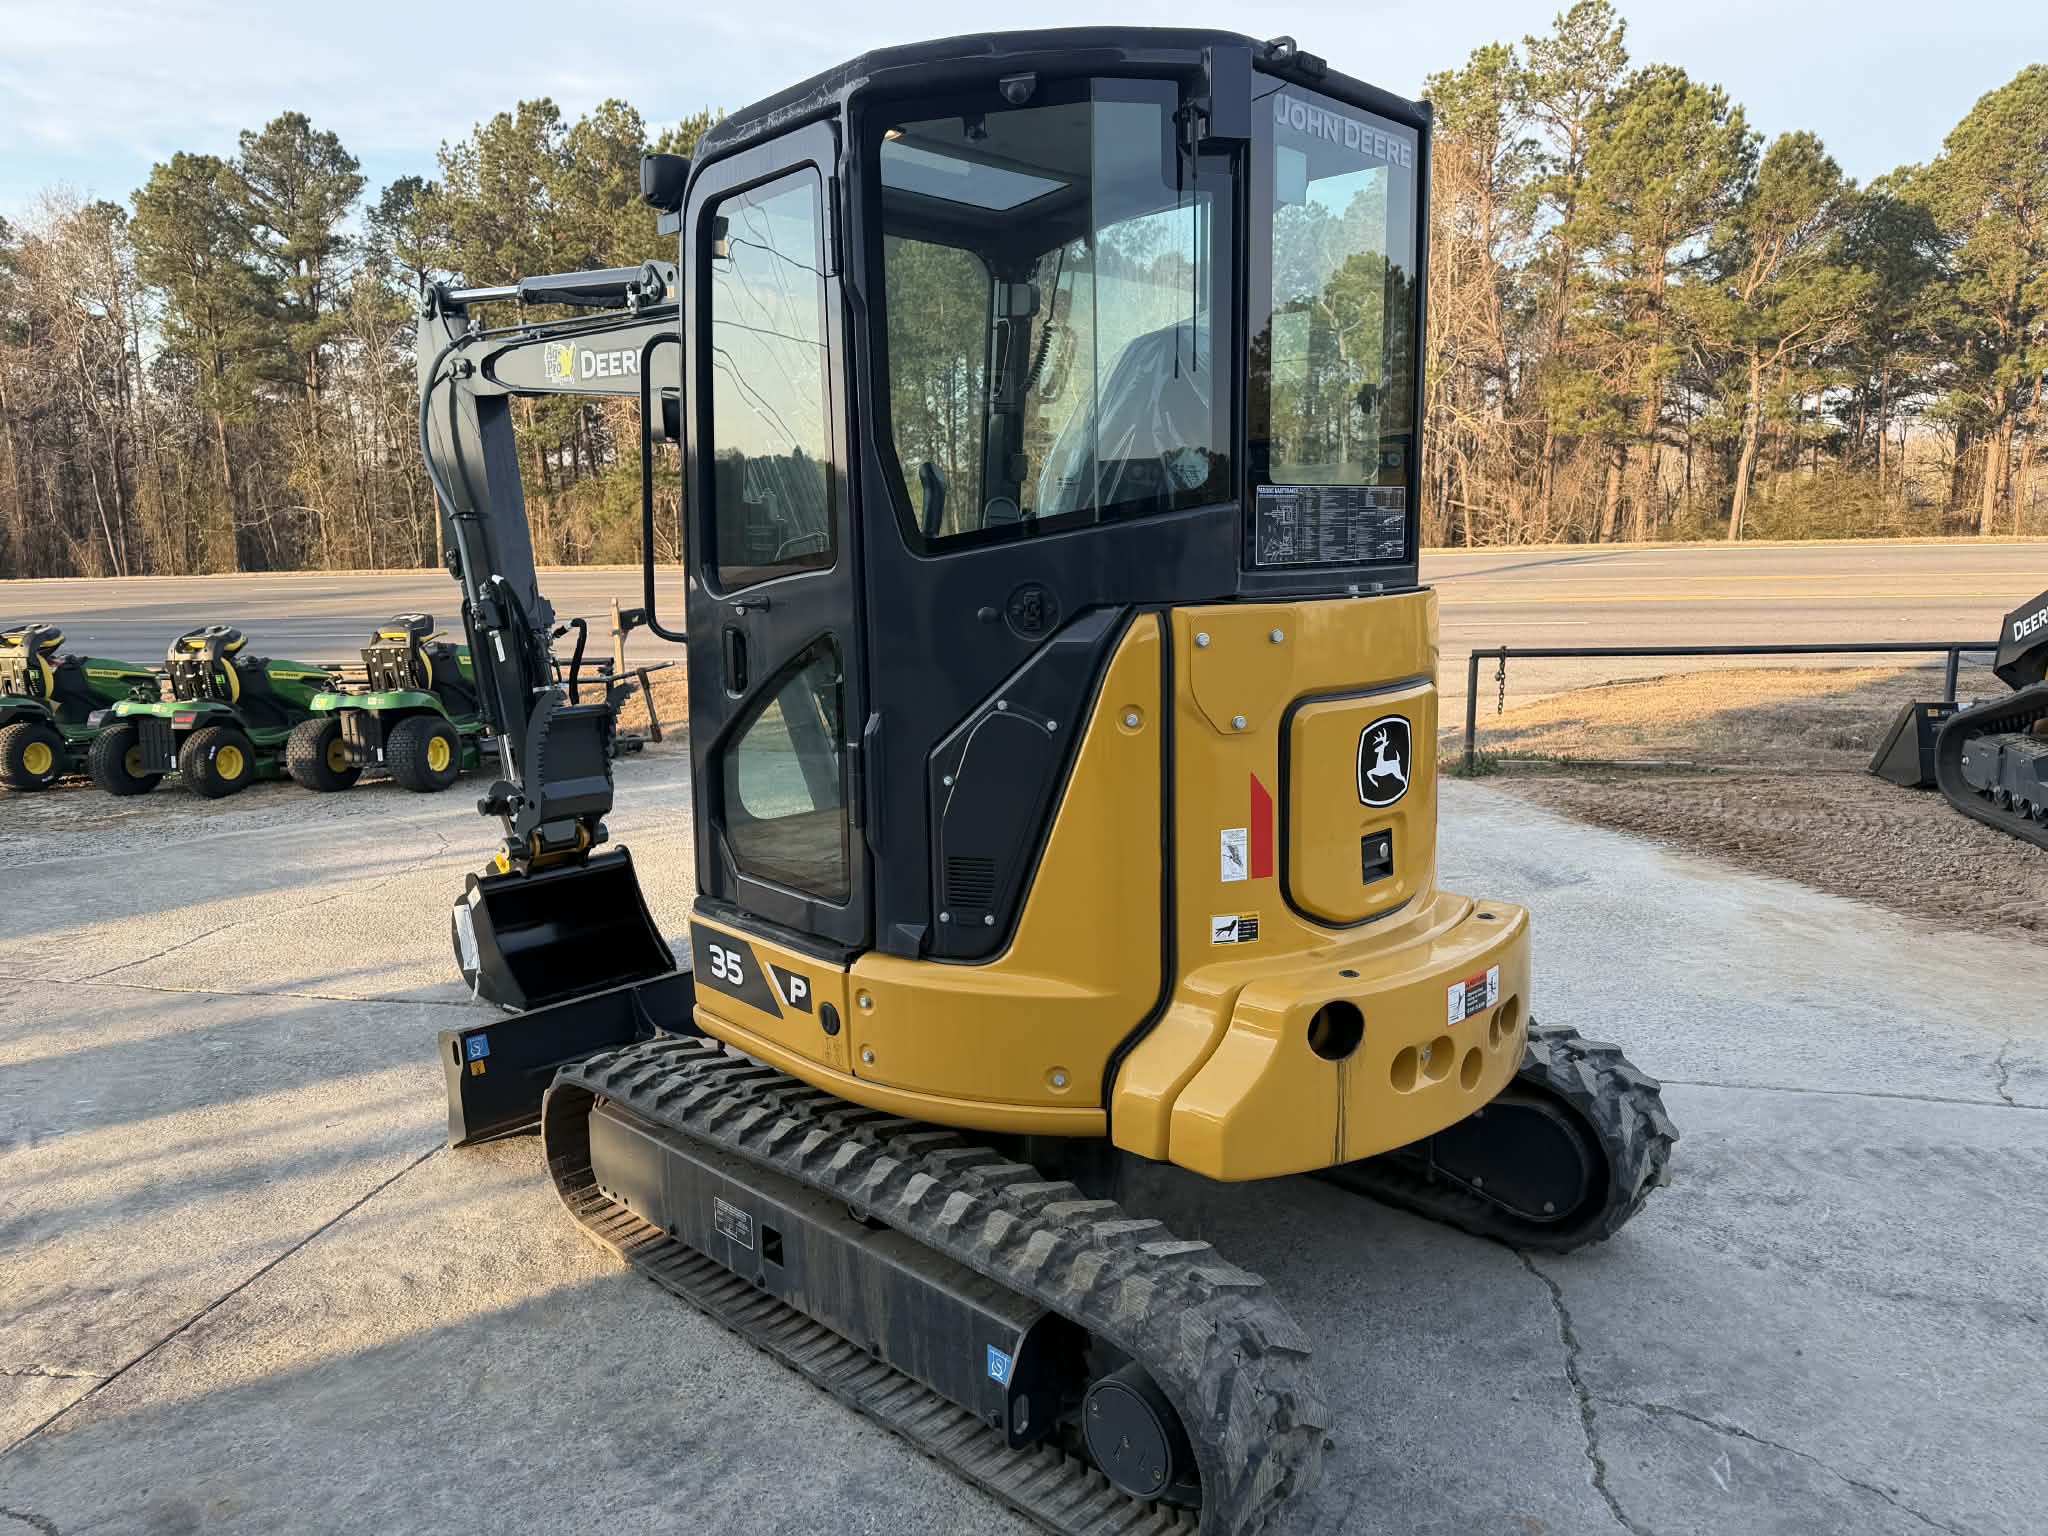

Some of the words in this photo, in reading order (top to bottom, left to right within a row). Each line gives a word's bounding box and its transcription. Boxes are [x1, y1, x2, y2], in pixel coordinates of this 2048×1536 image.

[1273, 93, 1339, 145] JOHN
[1344, 119, 1412, 169] DEERE
[2013, 605, 2048, 642] DEER
[709, 944, 744, 985] 35
[790, 975, 807, 1003] P
